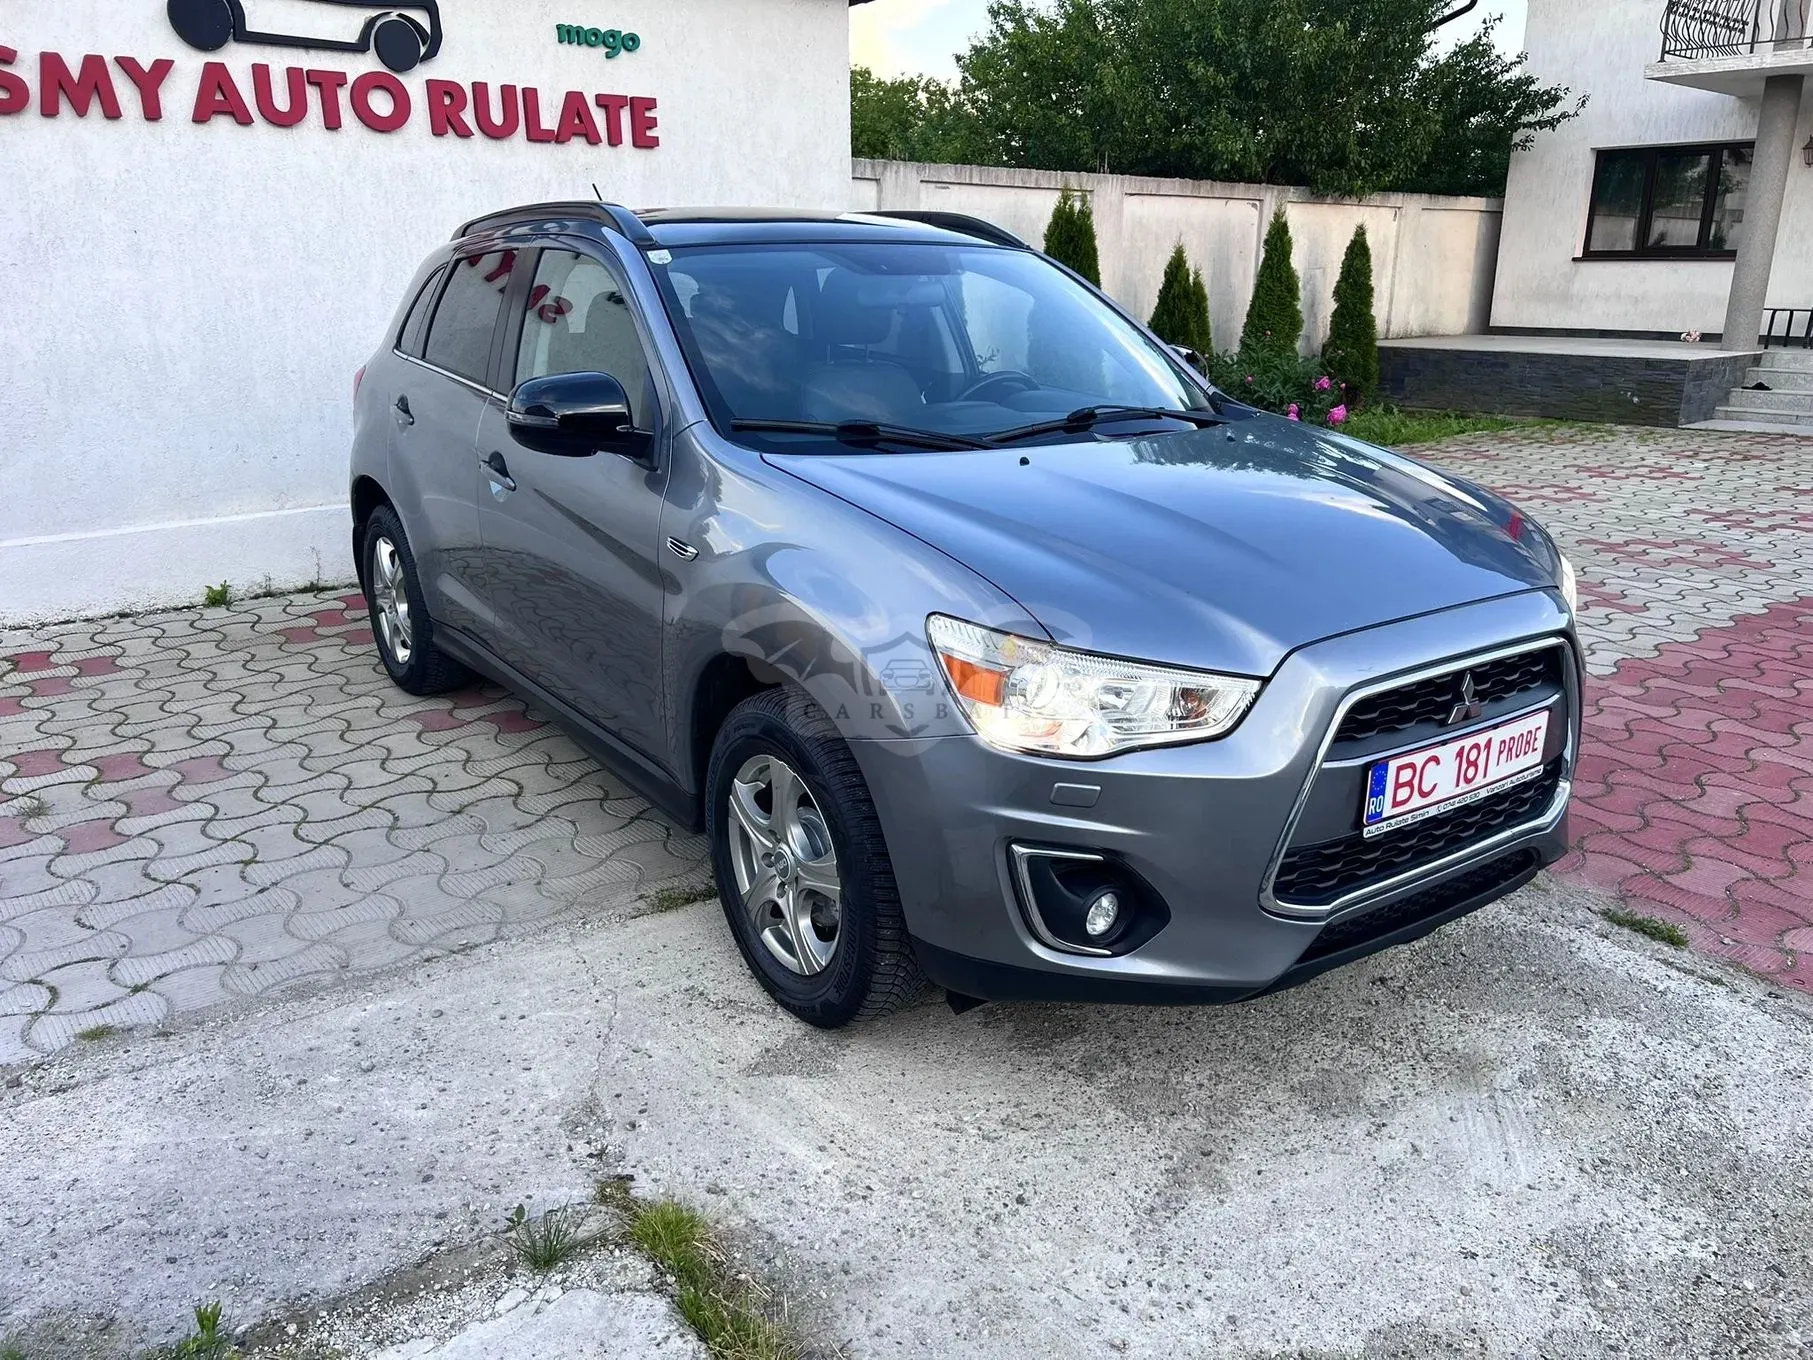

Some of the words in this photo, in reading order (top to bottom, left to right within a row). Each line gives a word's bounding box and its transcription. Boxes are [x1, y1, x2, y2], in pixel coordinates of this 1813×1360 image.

[556, 23, 641, 59] mogo
[192, 62, 412, 133] AUTO
[425, 79, 660, 149] RULATE
[1391, 755, 1441, 809] BC
[1454, 737, 1493, 787] 181
[1496, 726, 1542, 766] PROBE
[1368, 795, 1384, 816] RO
[1365, 824, 1385, 836] Auto
